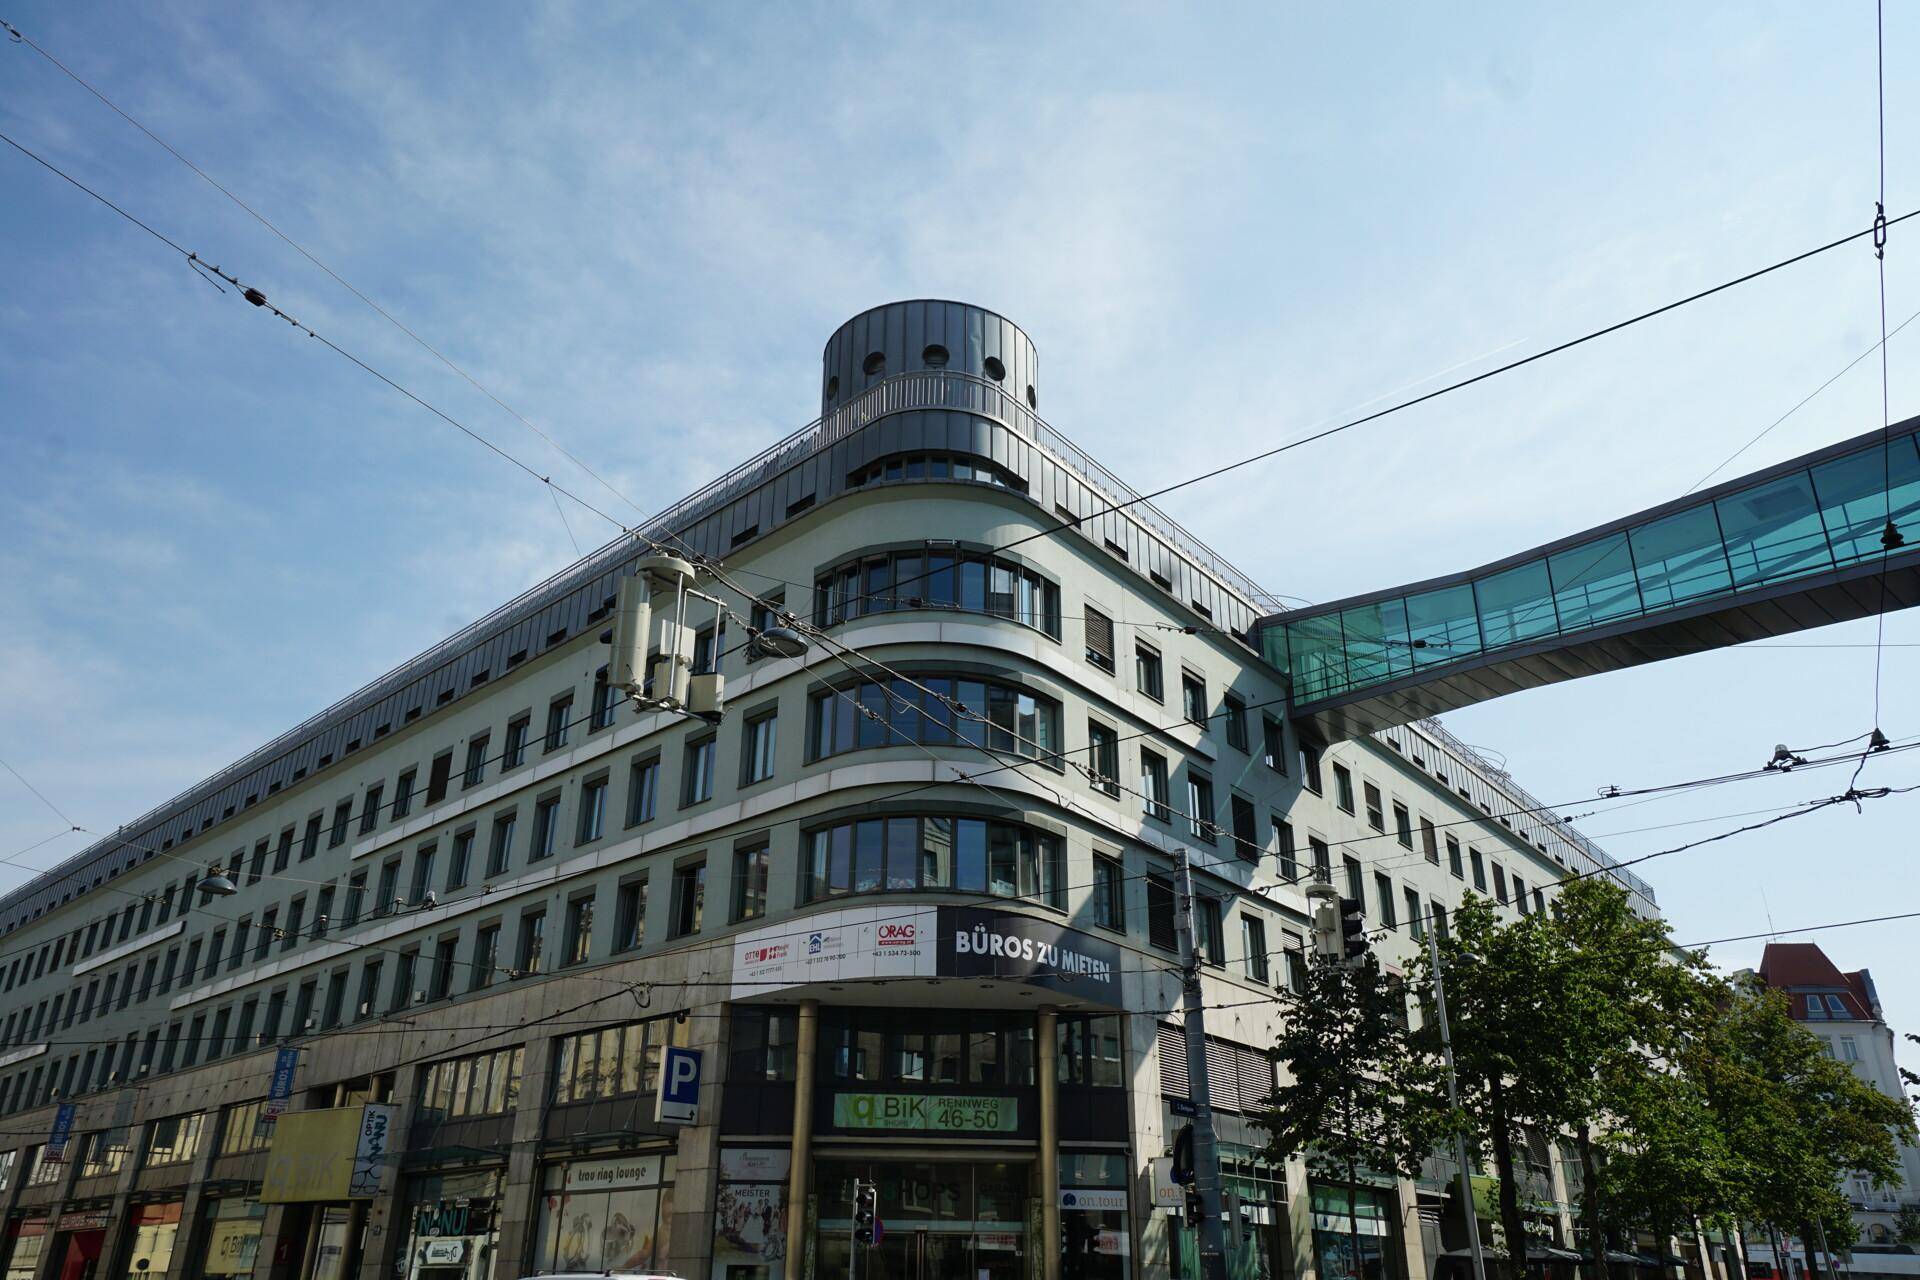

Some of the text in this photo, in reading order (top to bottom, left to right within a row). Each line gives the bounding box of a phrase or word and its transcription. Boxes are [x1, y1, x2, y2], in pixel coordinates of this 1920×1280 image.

[879, 924, 914, 938] ORAG
[956, 922, 1111, 984] BÜROS ZU MIETEN
[670, 1055, 697, 1095] P
[938, 1098, 999, 1109] RENNWEG
[365, 1110, 376, 1137] OPTIK
[937, 1109, 999, 1129] 46-50
[616, 1166, 647, 1180] lounge
[735, 1189, 770, 1198] MEISTER
[1079, 1193, 1125, 1208] on.tour
